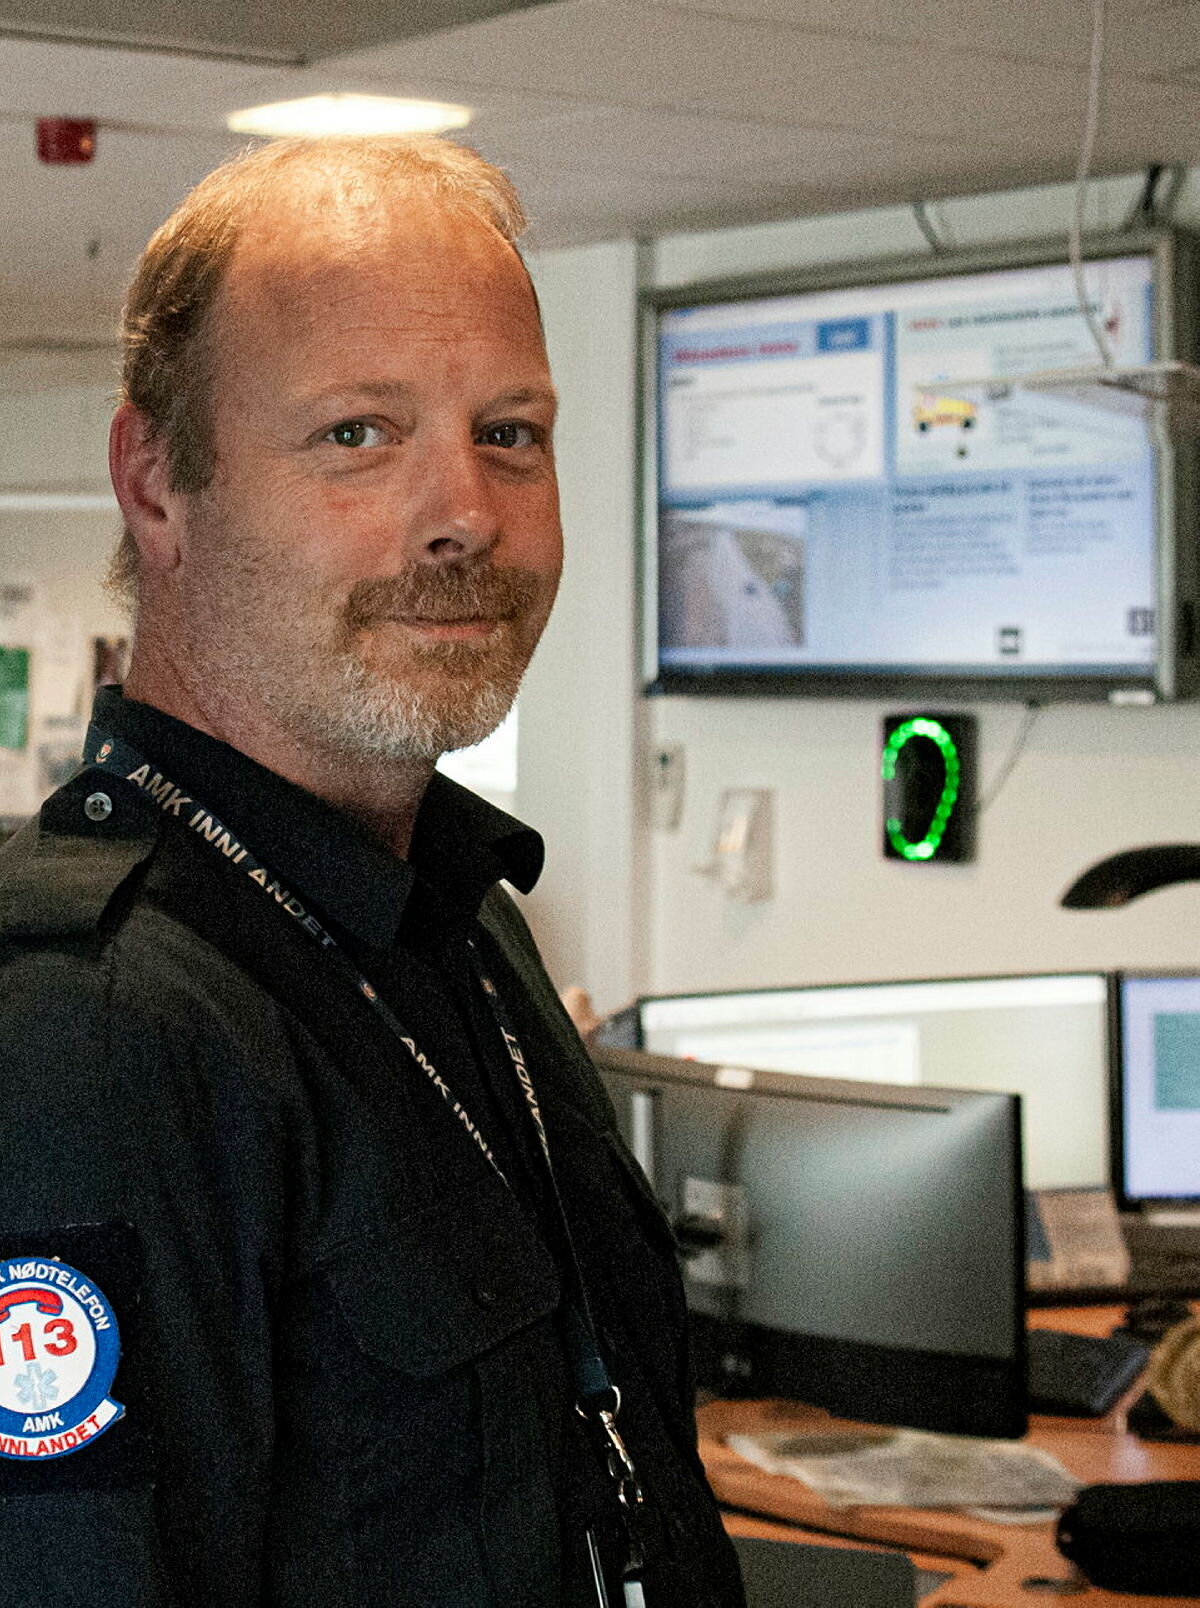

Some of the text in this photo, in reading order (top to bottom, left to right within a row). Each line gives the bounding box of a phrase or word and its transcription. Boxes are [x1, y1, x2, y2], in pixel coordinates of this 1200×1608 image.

[127, 764, 192, 817] AMK
[400, 1036, 451, 1099] AMK
[8, 1261, 111, 1332] NØDTELEFON
[22, 1411, 65, 1433] AMK
